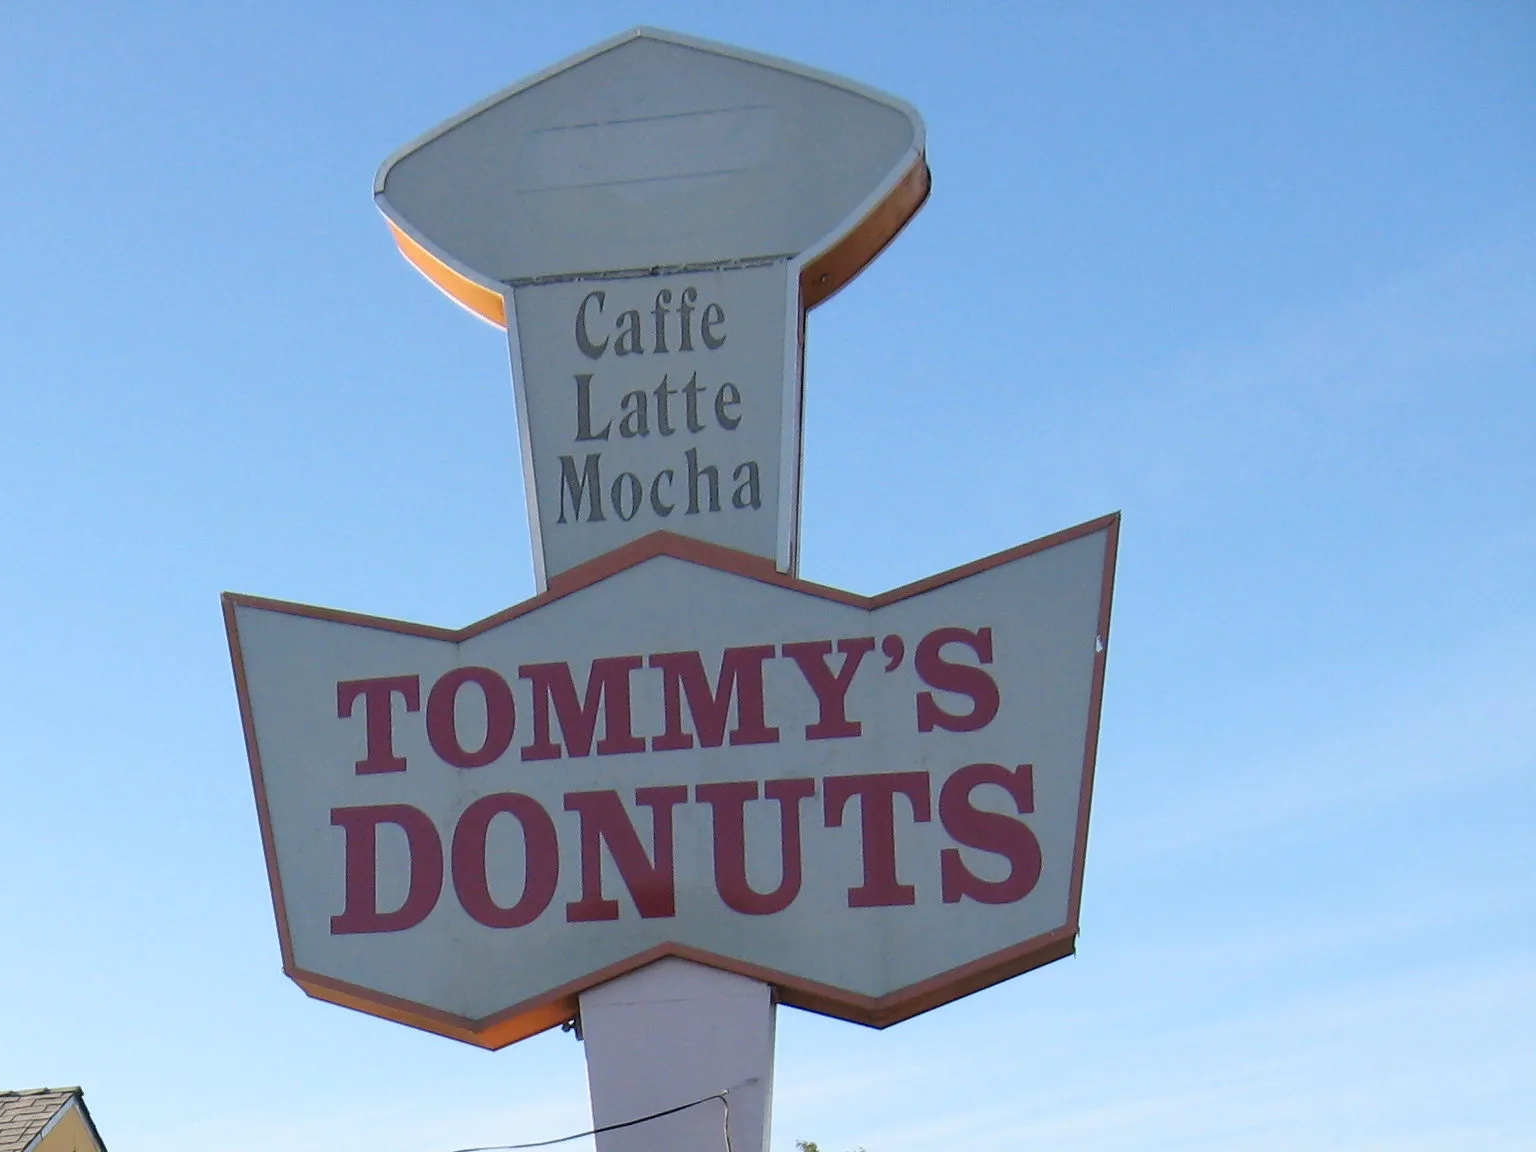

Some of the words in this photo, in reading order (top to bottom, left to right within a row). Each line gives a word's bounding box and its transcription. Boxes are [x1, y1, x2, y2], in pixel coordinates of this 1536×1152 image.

[575, 286, 727, 360] Caffe
[574, 371, 743, 442] Latte
[557, 447, 762, 524] Mocha
[336, 626, 1000, 776] TOMMY'S
[329, 762, 1043, 936] DONUTS
